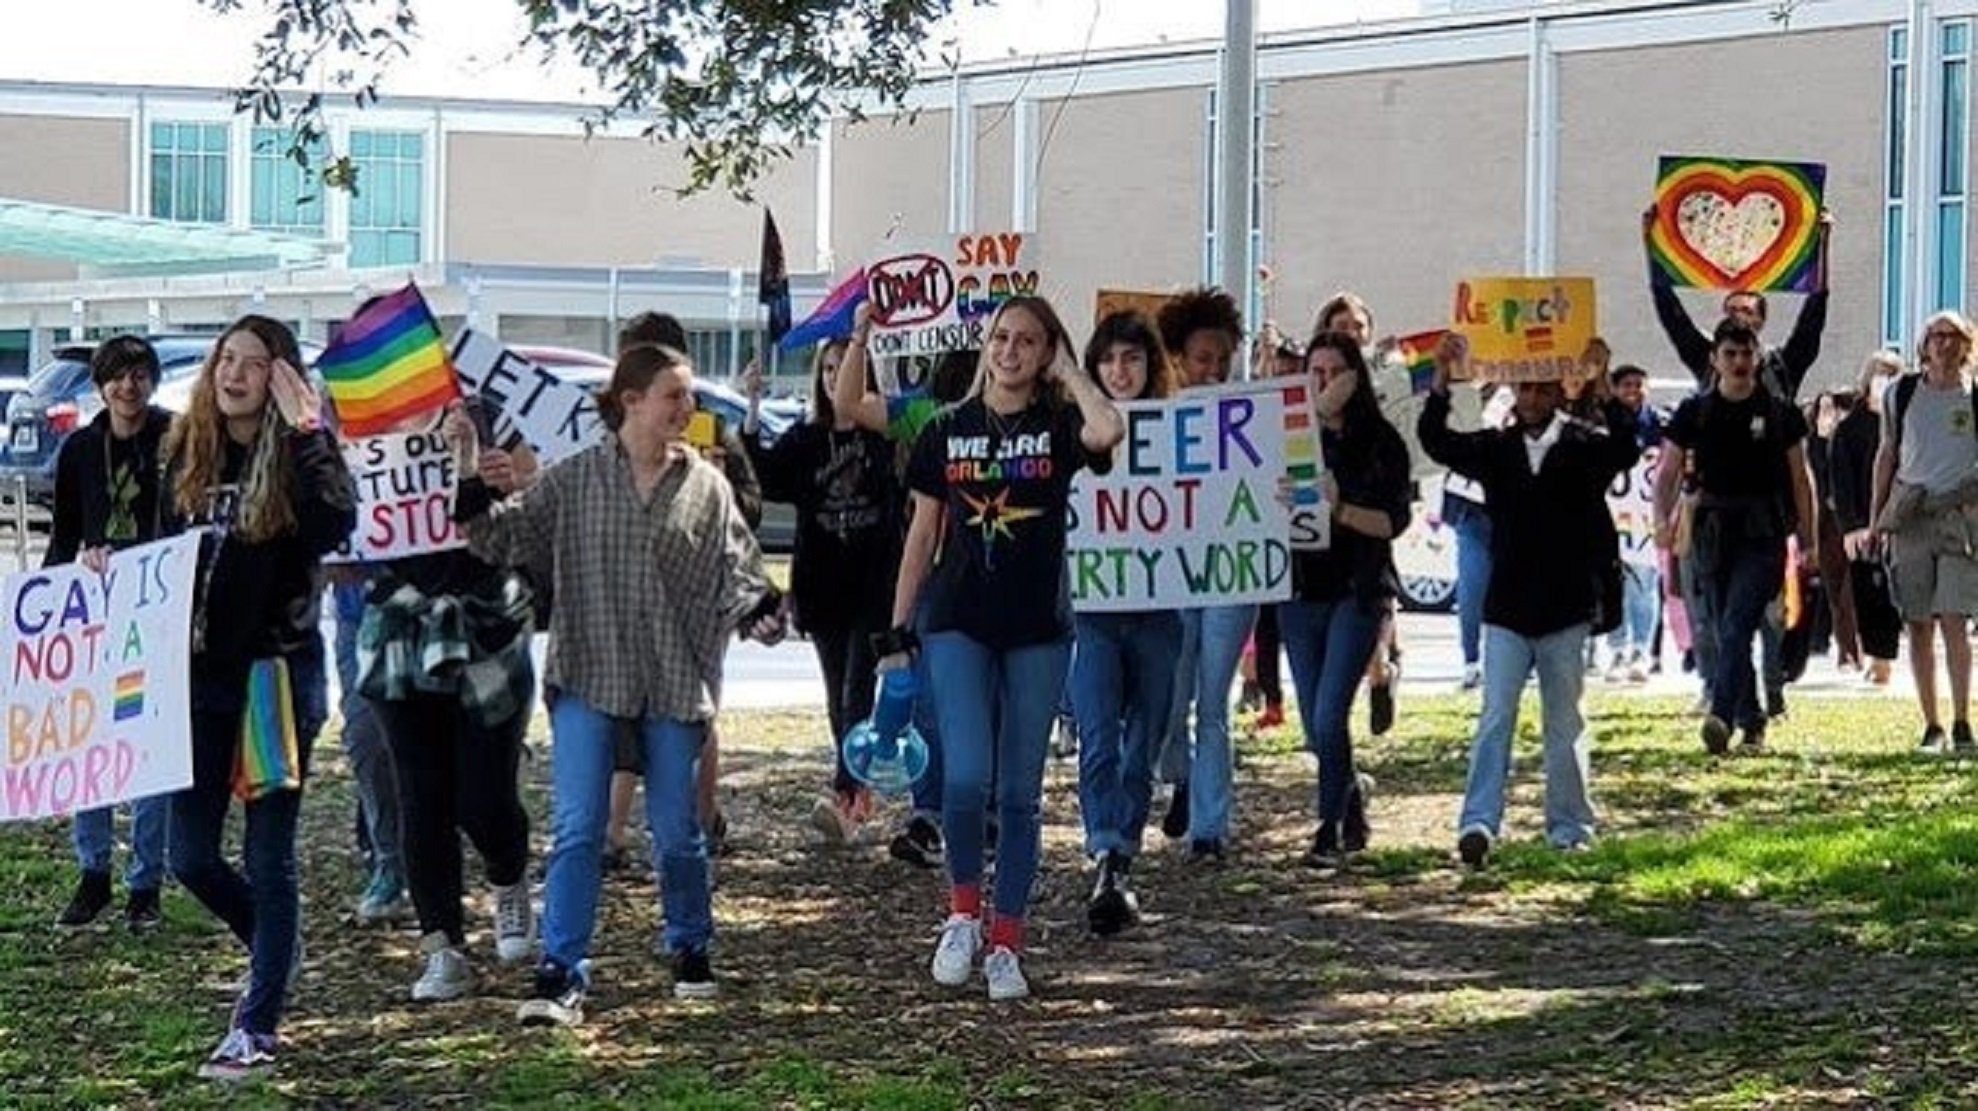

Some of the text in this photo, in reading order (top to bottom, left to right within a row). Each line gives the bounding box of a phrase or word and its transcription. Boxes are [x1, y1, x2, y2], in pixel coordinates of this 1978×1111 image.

[956, 233, 1022, 266] SAY
[956, 271, 1039, 324] GAY
[451, 329, 561, 418] LET
[405, 432, 449, 458] OU
[947, 430, 1051, 459] WE ARE
[1127, 398, 1264, 476] EER
[946, 457, 1053, 482] ORLANDO
[367, 492, 466, 549] STO
[1096, 479, 1202, 534] NOT
[1224, 477, 1260, 527] A
[15, 547, 172, 635] GAY IS
[1066, 538, 1290, 598] RTY WORD
[122, 619, 142, 662] A
[8, 687, 96, 765] BAD
[4, 738, 134, 818] WORD
